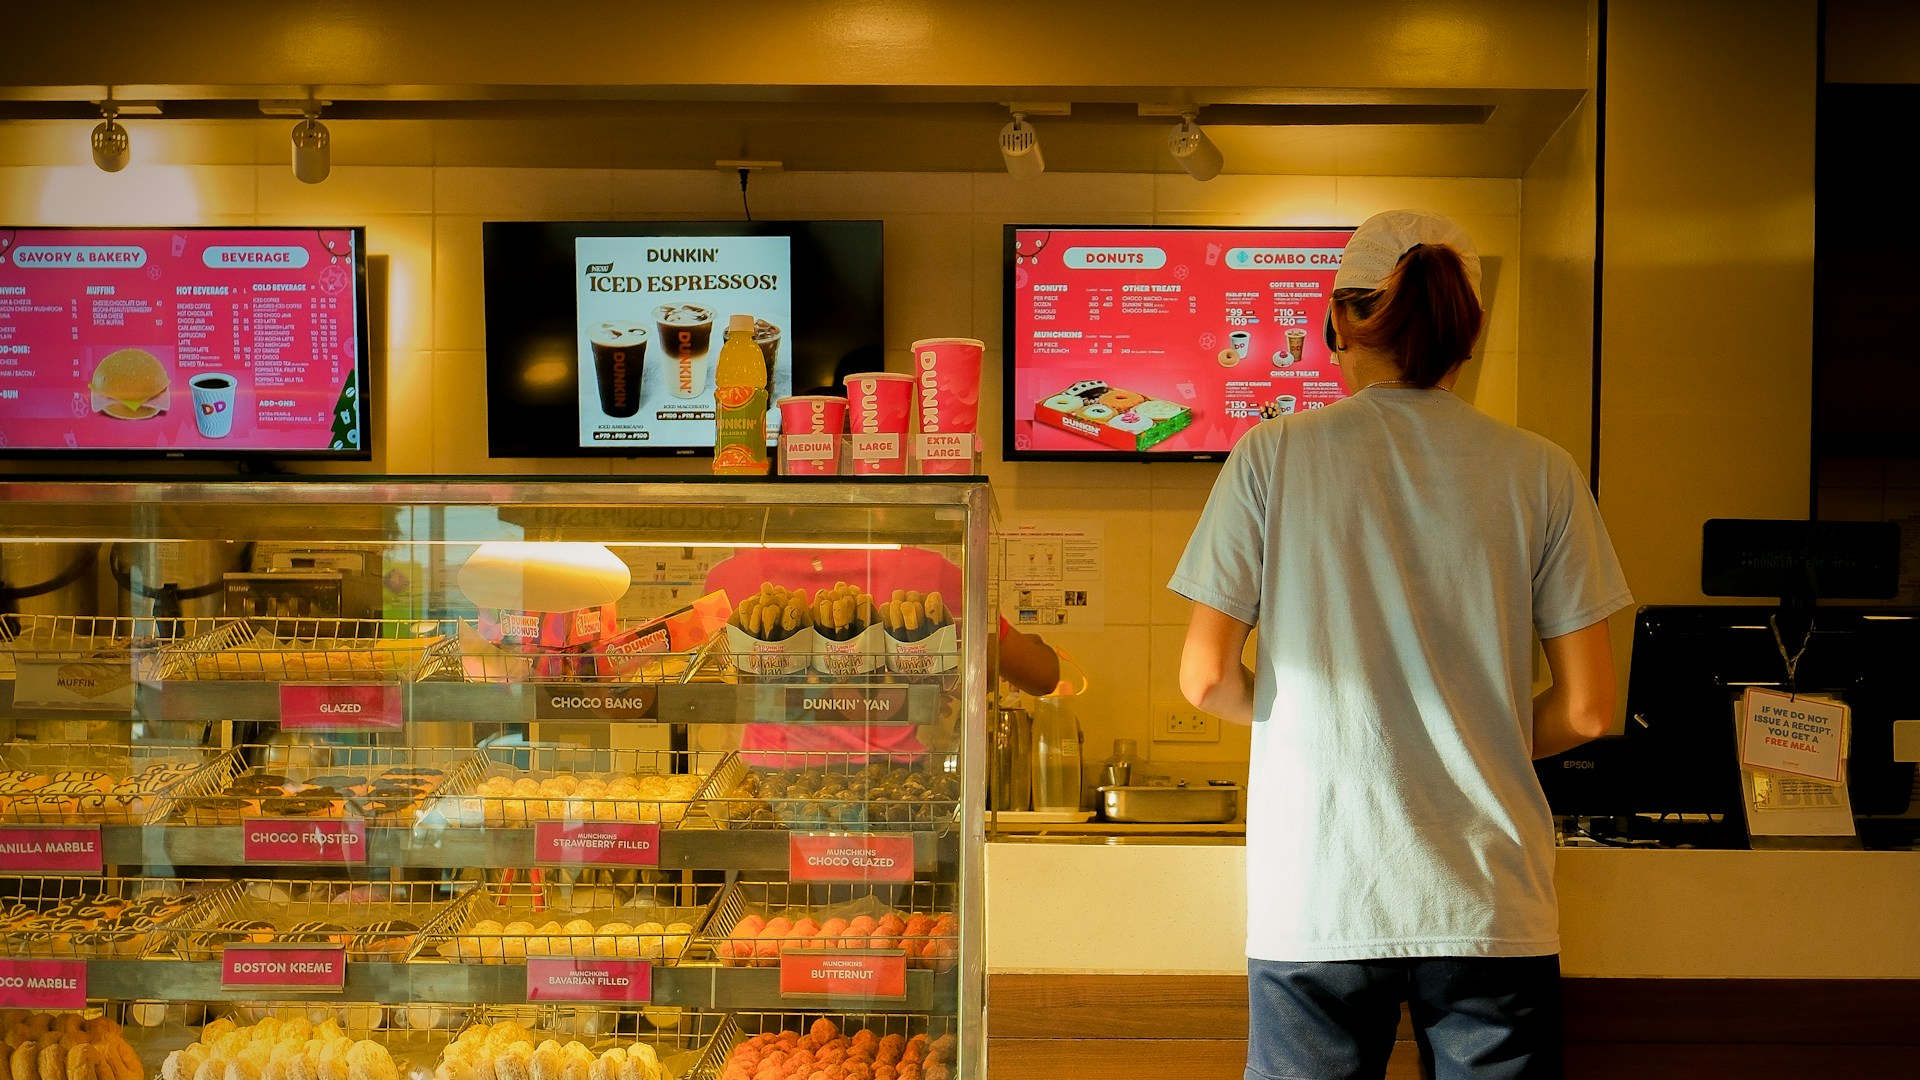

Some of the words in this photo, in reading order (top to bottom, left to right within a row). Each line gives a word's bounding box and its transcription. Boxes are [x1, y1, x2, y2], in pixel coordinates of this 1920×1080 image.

[19, 252, 72, 262] SAVORY
[76, 252, 84, 262] &
[89, 252, 141, 262] BAKERY
[222, 252, 290, 262] BEVERAGE
[647, 248, 719, 263] DUNKIN'
[1086, 253, 1144, 263] DONUTS
[1254, 254, 1306, 264] COMBO
[590, 276, 642, 292] ICED
[647, 274, 778, 291] ESPRESSOS!
[0, 286, 26, 295] NWICH
[86, 286, 115, 295] MUFFINS
[176, 286, 192, 295] HOT
[192, 286, 229, 295] BEVERAGE
[0, 345, 30, 354] DD-ONS:
[678, 331, 692, 394] DUNKIN'
[1062, 417, 1100, 434] DUNKIN'
[927, 437, 960, 445] EXTRA
[789, 443, 831, 452] MEDIUM
[927, 448, 960, 457] LARGE
[511, 616, 538, 626] DUNKIN'
[512, 626, 538, 637] DONUTS
[622, 630, 667, 654] DUNKIN'
[57, 678, 95, 688] MUFFIN
[552, 697, 601, 709] CHOCO
[605, 697, 642, 709] BANG
[803, 700, 860, 710] DUNKIN'
[863, 700, 889, 710] YAN
[320, 703, 362, 714] GLAZED
[1762, 705, 1770, 713] IF
[1773, 708, 1788, 716] WE
[1808, 714, 1828, 725] NOT
[1754, 715, 1780, 726] ISSUE
[1783, 719, 1790, 728] A
[1768, 727, 1789, 738] YOU
[1791, 732, 1810, 741] GET
[1765, 737, 1788, 748] FREE
[1790, 742, 1820, 754] MEAL.
[1563, 761, 1594, 769] EPSON
[251, 832, 298, 844] CHOCO
[302, 832, 358, 844] FROSTED
[0, 842, 42, 853] ANILLA
[45, 842, 94, 853] MARBLE
[553, 839, 616, 849] STRAWBERRY
[618, 841, 649, 849] FILLED
[808, 857, 849, 867] CHOCO
[852, 857, 894, 867] GLAZED
[233, 962, 286, 973] BOSTON
[290, 962, 332, 973] KREME
[811, 970, 873, 979] BUTTERNUT
[0, 977, 24, 987] OCO
[27, 978, 76, 989] MARBLE
[549, 977, 595, 986] BAVARIAN
[598, 977, 629, 986] FILLED
